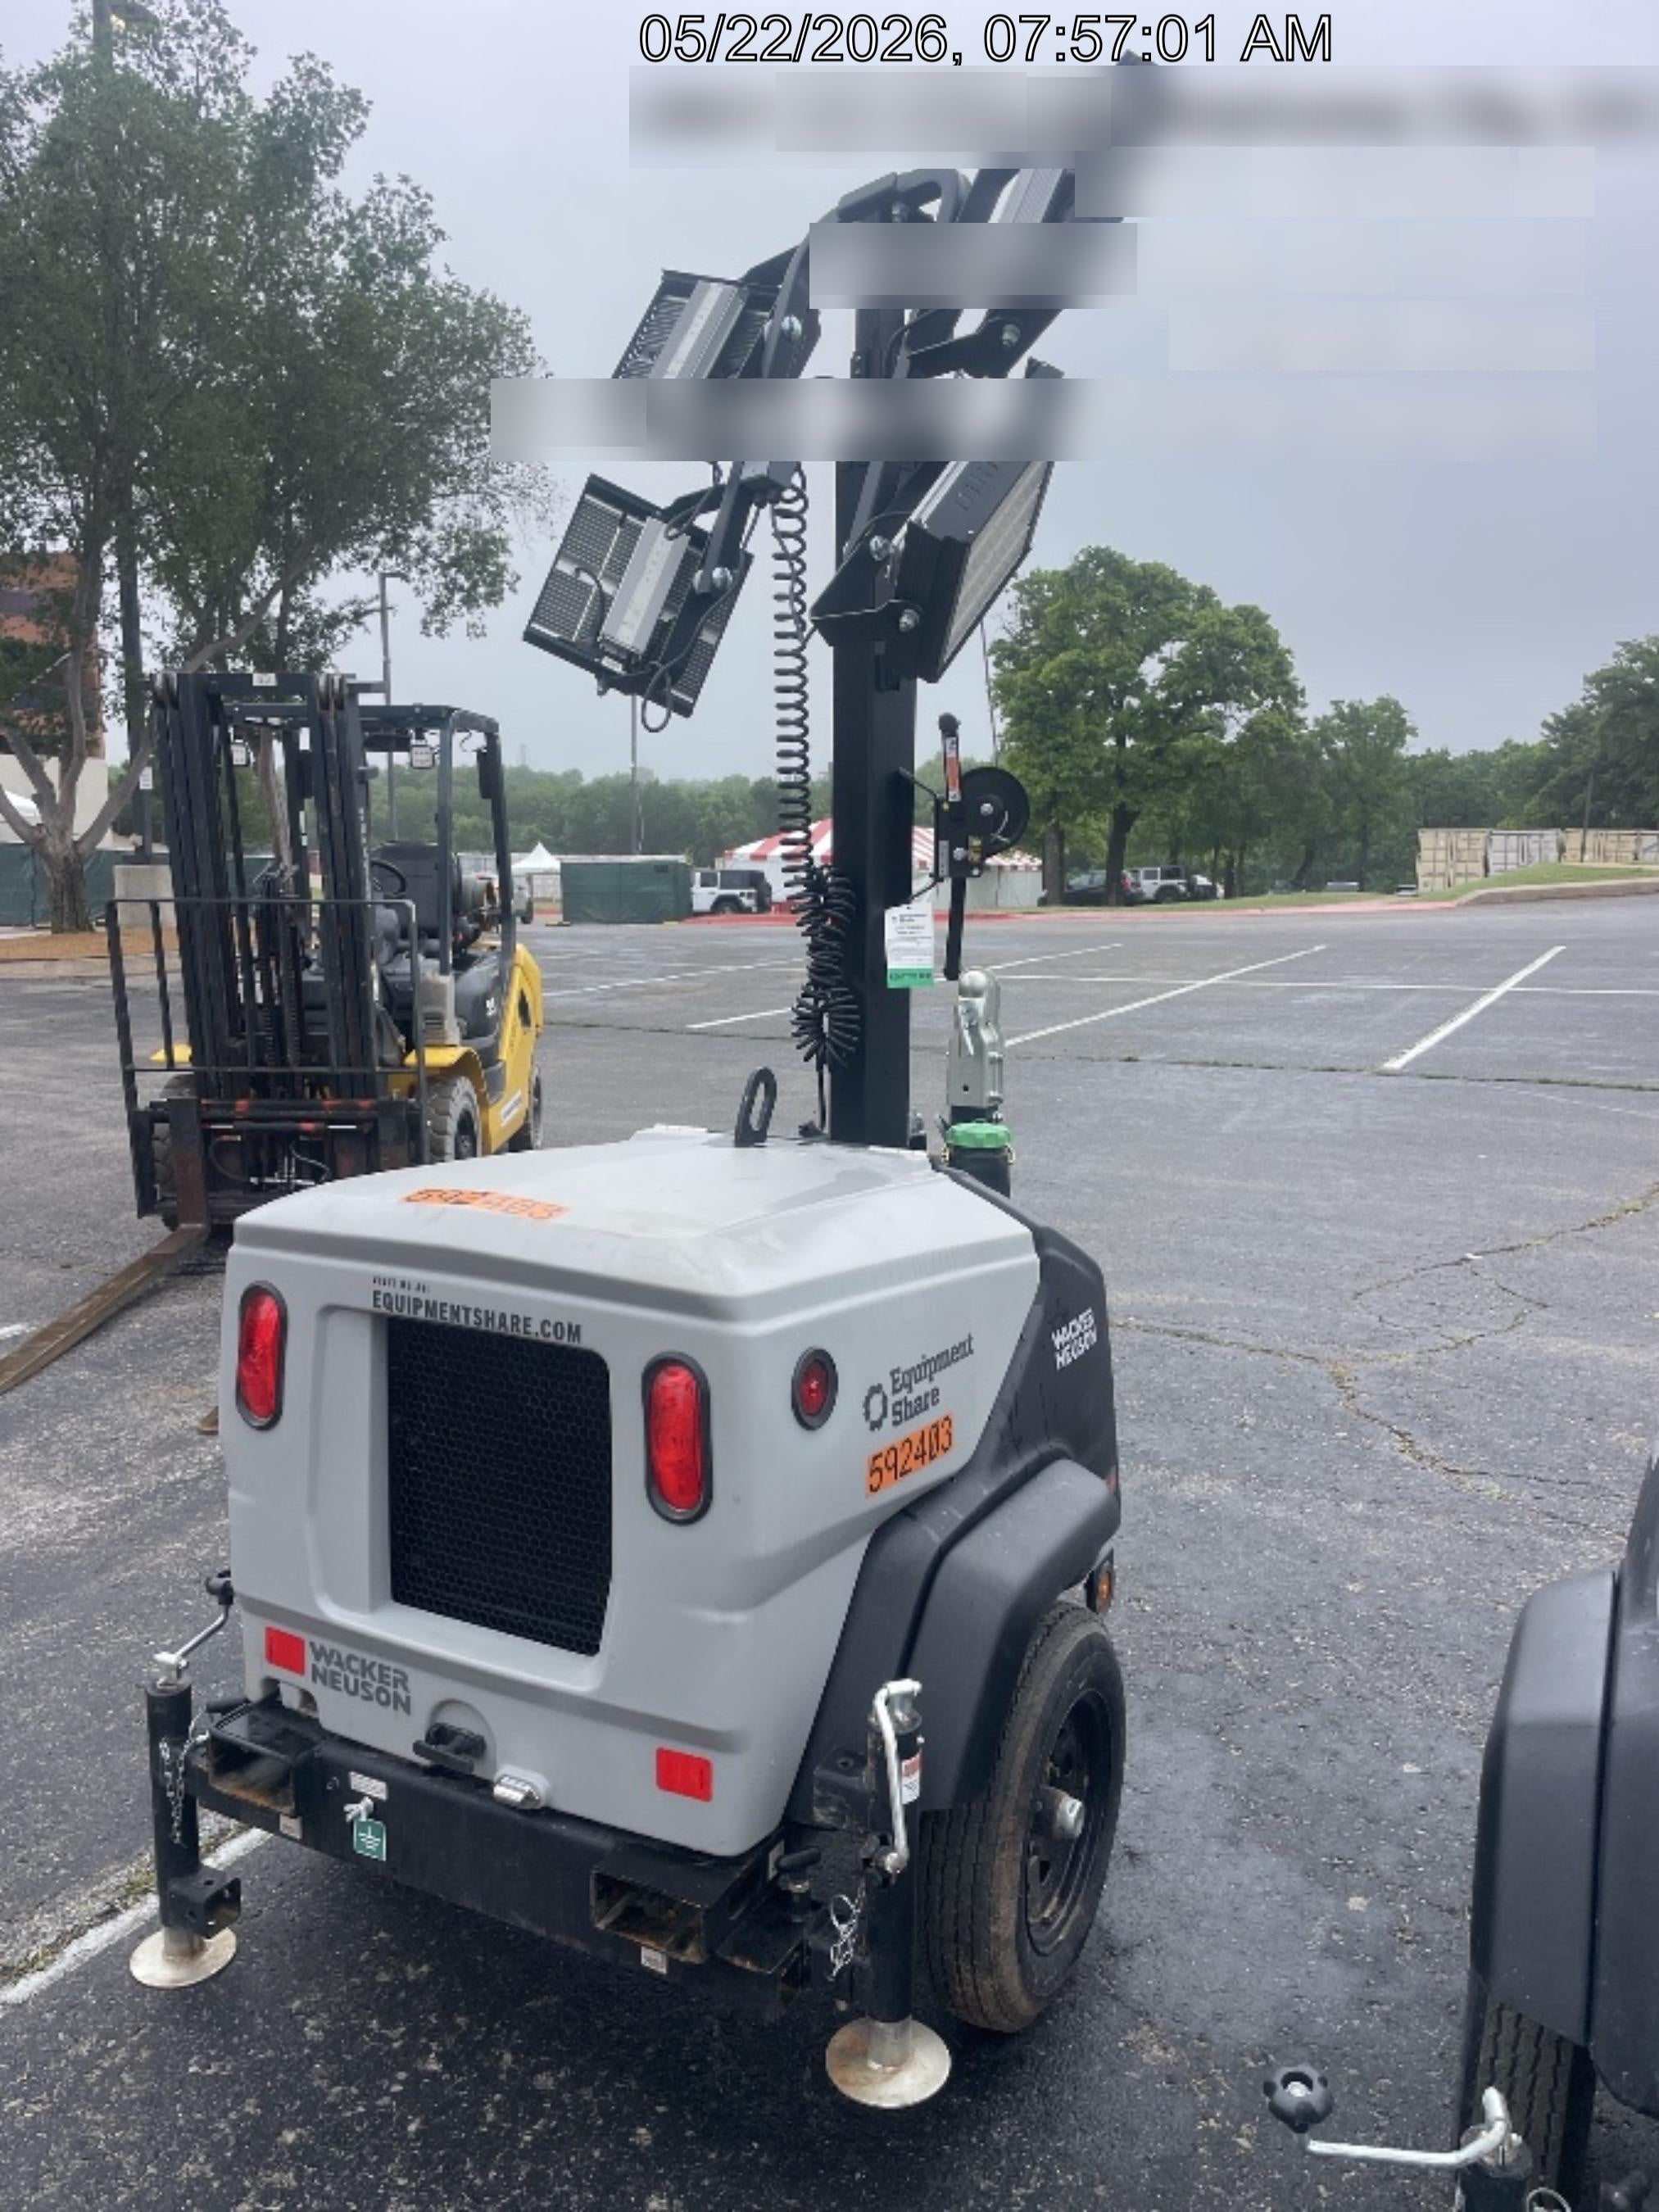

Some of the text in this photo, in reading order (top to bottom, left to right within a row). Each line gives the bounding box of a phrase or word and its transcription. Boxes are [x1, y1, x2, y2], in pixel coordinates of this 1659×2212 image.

[373, 1290, 582, 1344] EQUIPMENTSHARE.COM
[890, 1333, 974, 1394] Equipment
[891, 1386, 941, 1426] Share
[869, 1415, 953, 1493] 592403
[309, 1641, 410, 1693] WACKER
[311, 1663, 411, 1716] NEUSON
